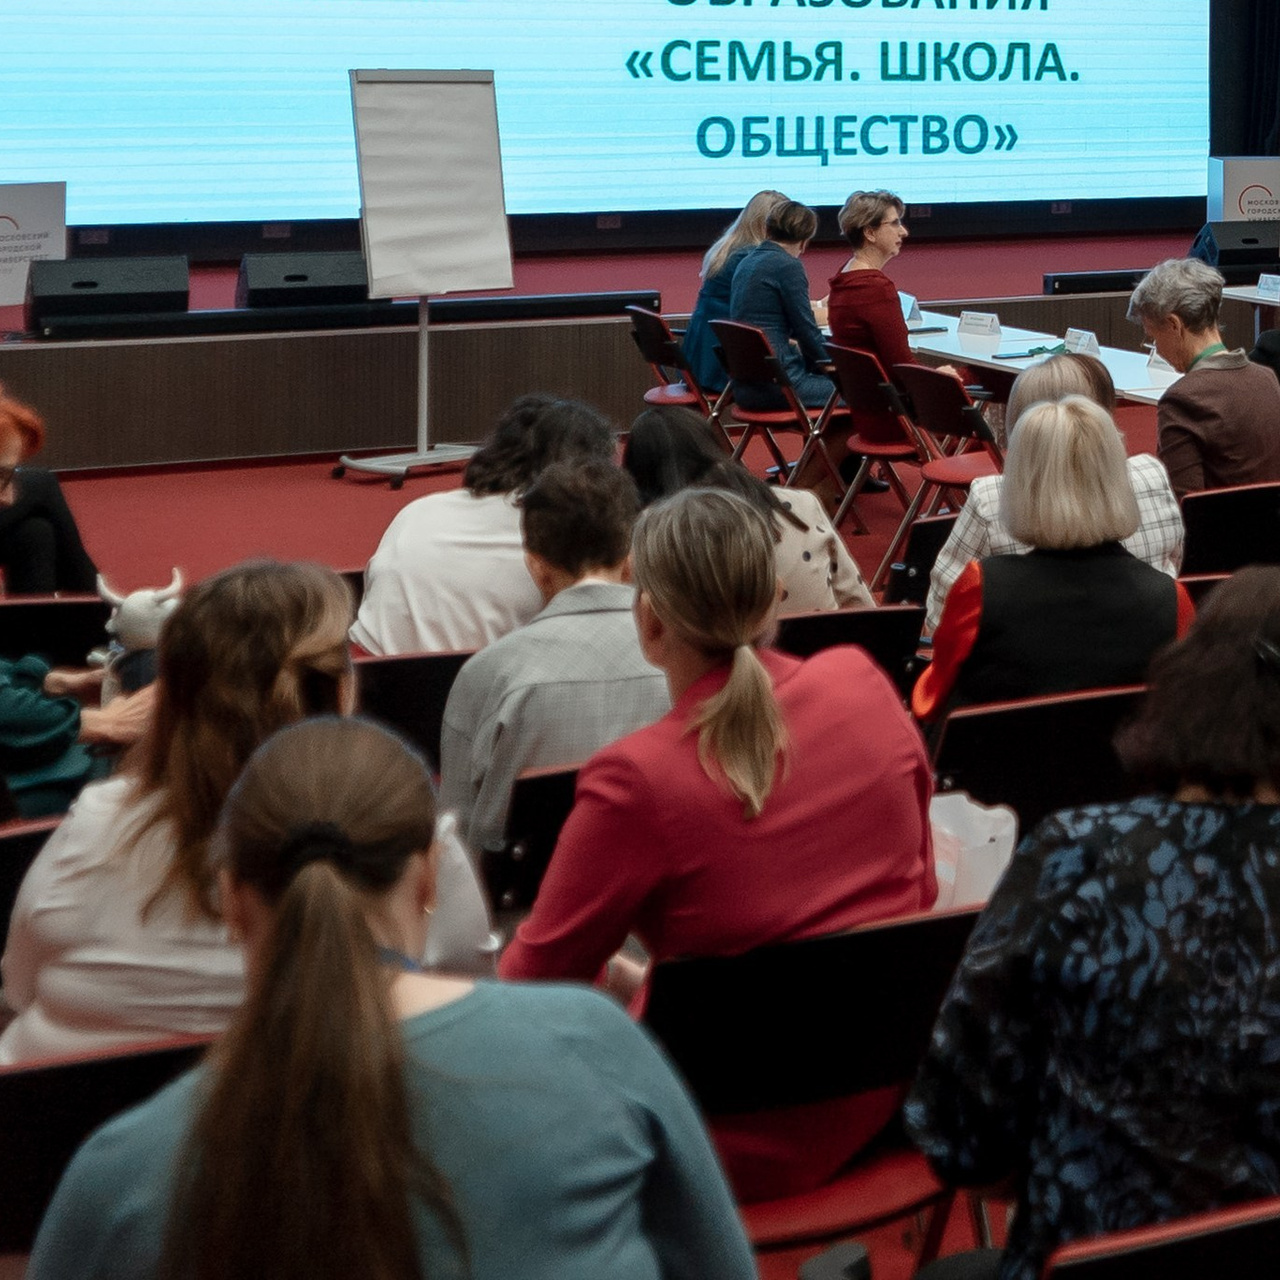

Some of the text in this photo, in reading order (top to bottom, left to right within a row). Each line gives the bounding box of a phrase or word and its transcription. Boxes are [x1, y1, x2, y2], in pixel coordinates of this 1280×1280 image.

[625, 39, 1080, 82] «СЕМЬЯ. ШКОЛА.
[696, 114, 1019, 166] ОБЩЕСТВО»
